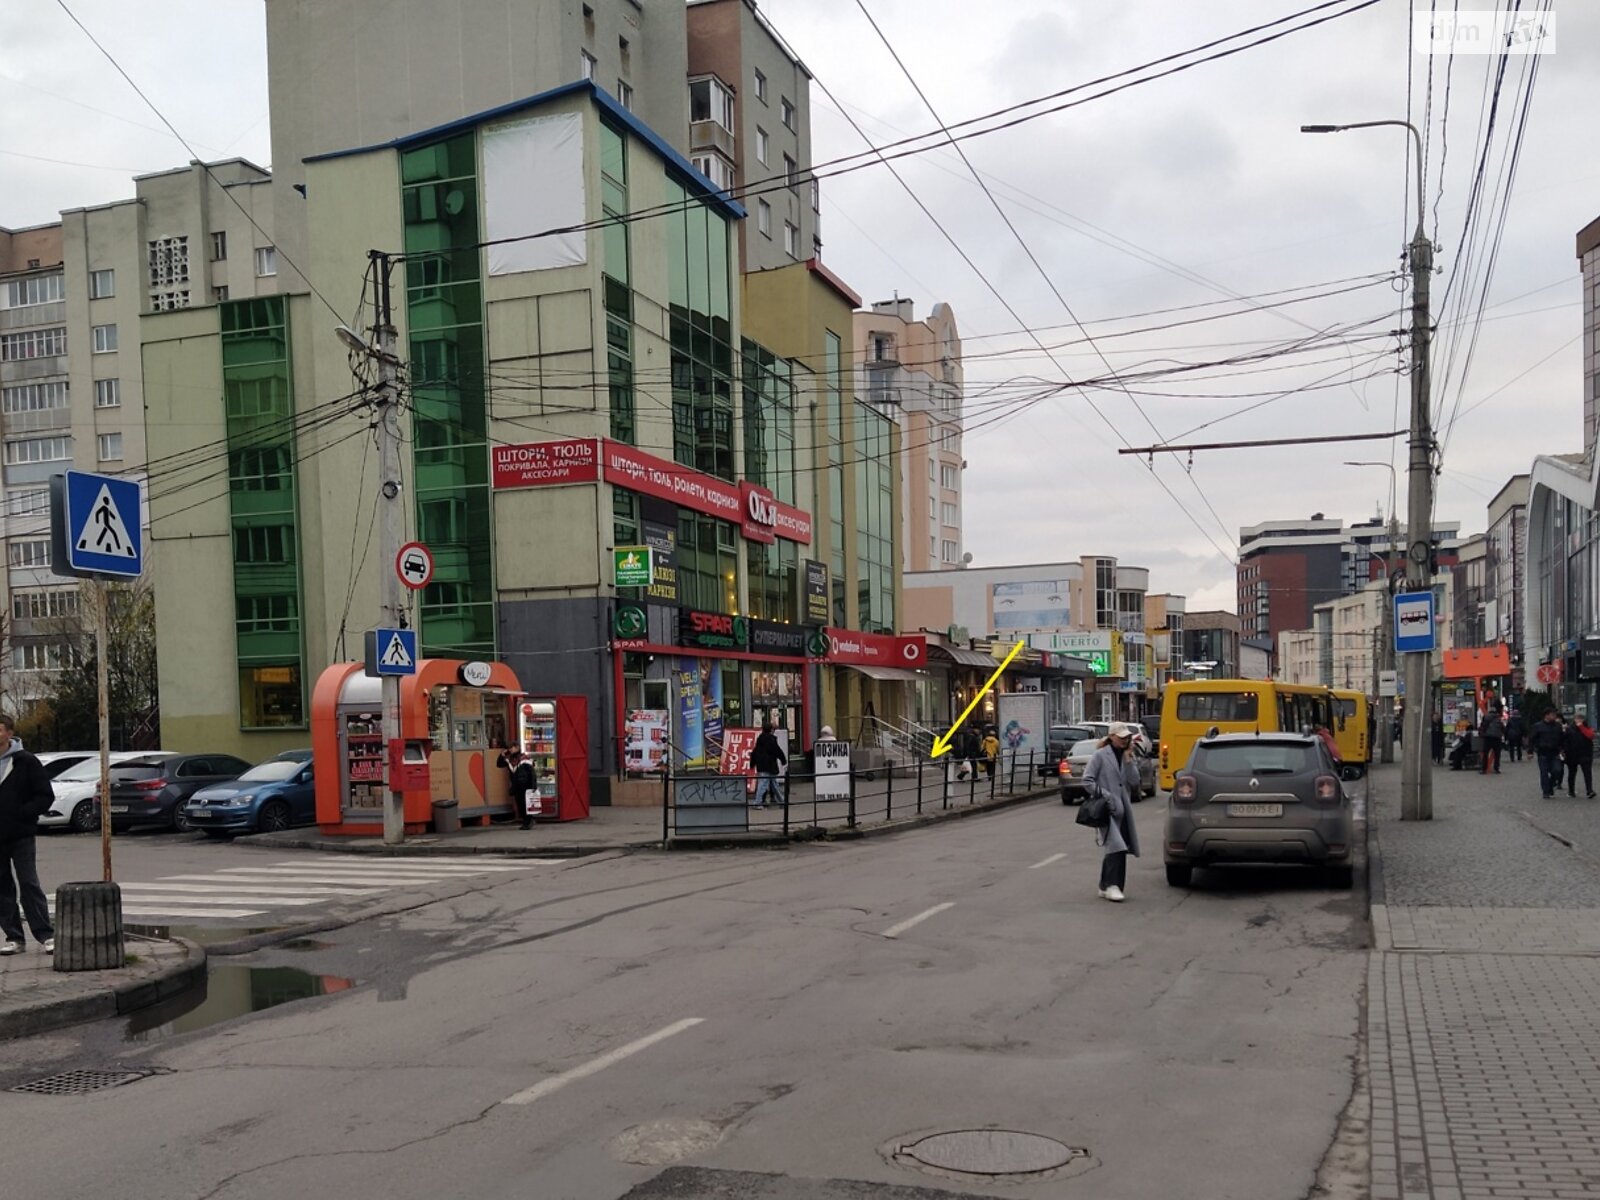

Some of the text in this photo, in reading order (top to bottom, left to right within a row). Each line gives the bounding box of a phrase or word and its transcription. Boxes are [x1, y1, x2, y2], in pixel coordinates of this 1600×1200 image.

[498, 443, 592, 463] ШТОРИ, ТЮЛЬ
[498, 460, 550, 472] ПОКРИВАЛА,
[521, 468, 569, 480] АКСЕСУАРИ
[611, 454, 647, 481] штори,
[707, 489, 739, 511] карнизи
[689, 612, 733, 634] SPAR
[613, 640, 645, 649] SPAR
[754, 629, 803, 647] СУПЕРМАРКЕТ
[1062, 638, 1100, 646] VERTO
[729, 734, 743, 775] ШТОР
[816, 743, 849, 757] ПОЗИКА
[826, 759, 838, 769] 5%
